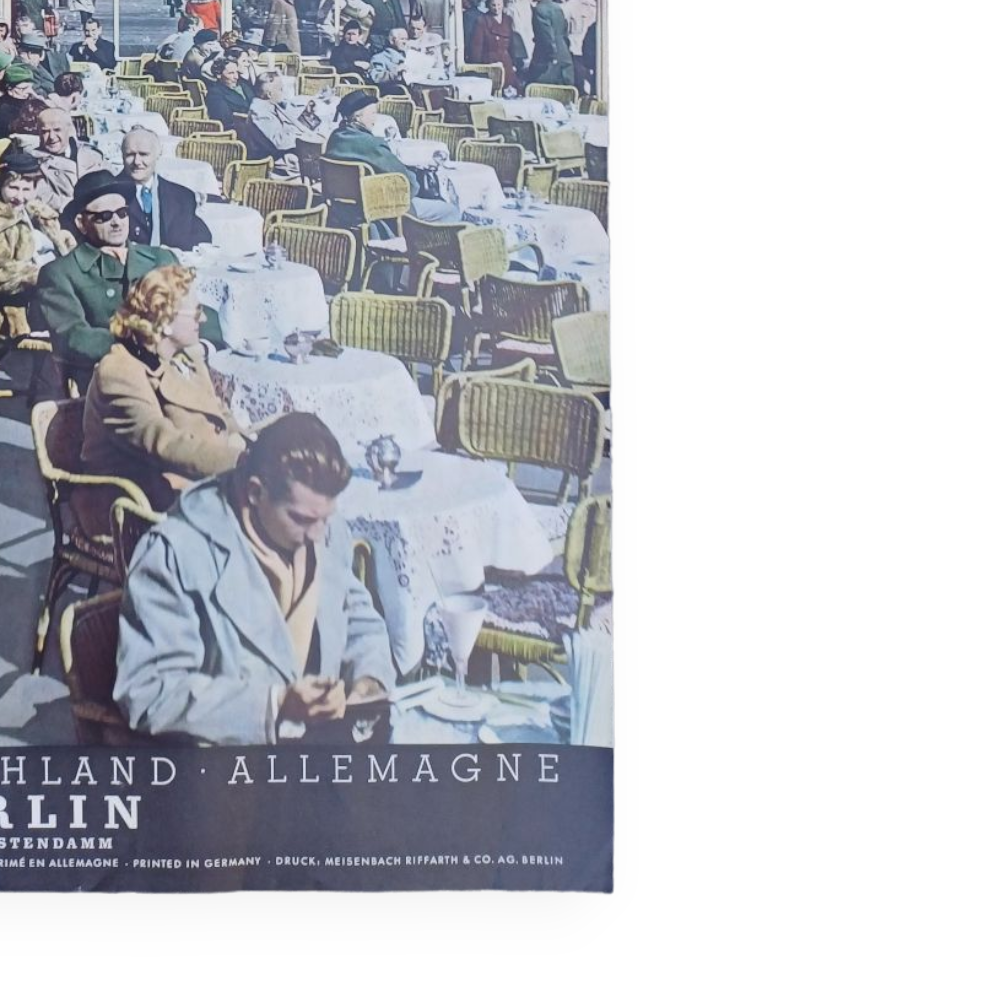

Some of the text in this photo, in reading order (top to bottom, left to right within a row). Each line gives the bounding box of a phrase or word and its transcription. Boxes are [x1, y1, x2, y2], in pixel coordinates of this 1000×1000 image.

[227, 753, 560, 785] ALLEMAGNE
[28, 858, 46, 868] EN
[48, 857, 119, 868] ALLEMAGNE
[132, 858, 183, 869] PRINTED
[185, 858, 200, 869] IN
[203, 857, 262, 869] GERMANY
[324, 856, 401, 867] MEISENBACH
[405, 855, 459, 866] RIFFARTH
[462, 855, 471, 866] &
[473, 854, 495, 865] CO.
[521, 855, 564, 866] BERLIN
